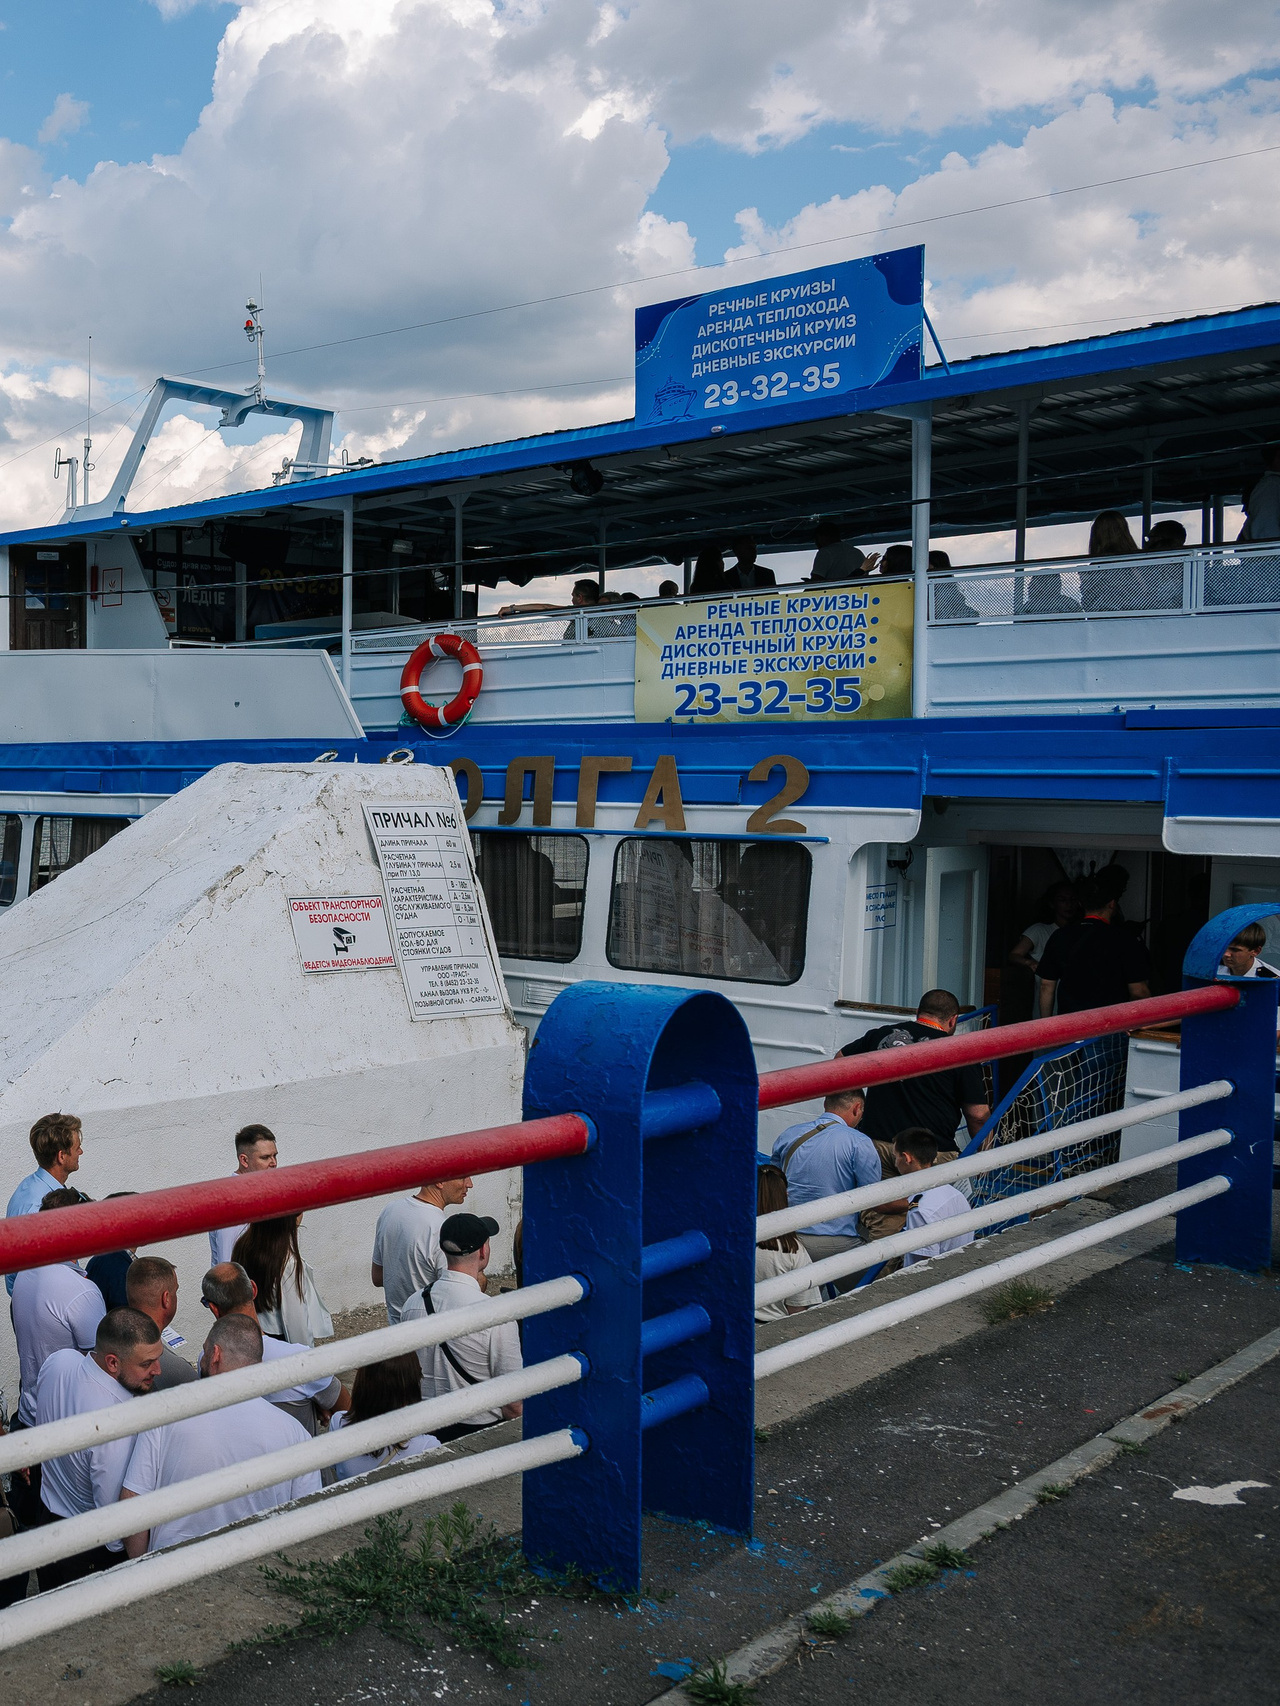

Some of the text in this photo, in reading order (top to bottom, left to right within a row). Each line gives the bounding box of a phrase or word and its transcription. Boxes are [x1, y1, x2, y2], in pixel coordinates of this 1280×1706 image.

[709, 278, 835, 317] РЕЧНЫЕ КРУИЗЫ
[697, 296, 850, 338] АРЕНДА ТЕПЛОХОДА
[691, 314, 857, 360] ДИСКОТЕЧНЫЙ КРУИЗ
[691, 333, 856, 378] ДНЕВНЫЕ ЭКСКУРСИИ
[704, 362, 841, 409] 23-32-35
[707, 593, 869, 620] РЕЧНЫЕ КРУИЗЫ
[674, 613, 868, 641] АРЕНДА ТЕПЛОХОДА
[660, 632, 866, 662] ДИСКОТЕЧНЫЙ КРУИЗ
[661, 652, 865, 679] ДНЕВНЫЕ ЭКСКУРСИИ
[674, 676, 863, 717] 23-32-35
[746, 754, 811, 834] 2
[371, 811, 457, 830] ПРИЧАЛ №6
[380, 839, 429, 847] ДЛИНА ПРИЧАЛА
[446, 840, 452, 848] 60
[383, 853, 416, 861] РАСЧЕТНАЯ
[385, 861, 412, 869] ГЛУБИНА
[417, 861, 443, 869] ПРИЧАЛА
[387, 869, 421, 879] при ПУ 13,0
[391, 886, 425, 895] РАСЧЕТНАЯ
[392, 894, 443, 903] ХАРАКТЕРИСТИКА
[292, 898, 383, 912] ОБЪЕКТ ТРАНСПОРТНОЙ
[394, 902, 451, 911] ОБСЛУЖИВАЕМОГО
[308, 912, 371, 924] БЕЗОПАСНОСТИ
[395, 912, 419, 921] СУДНА
[399, 929, 445, 940] ДОПУСКАЕМОЕ
[400, 938, 438, 948] КОЛ-ВО ДЛЯ
[402, 946, 452, 956] СТОЯНКИ СУДОВ
[303, 956, 394, 970] ВЕДЕТСЯ ВИДЕОНАБЛЮДЕНИЕ
[420, 962, 479, 972] УПРАВЛЕНИЕ ПРИЧАЛОМ
[460, 977, 480, 986] 23-32-35
[420, 990, 439, 998] КАНАЛ
[440, 989, 460, 997] ВЫЗОВА
[414, 999, 444, 1008] ПОЗЫВНОЙ
[445, 998, 464, 1007] СИГНАЛ
